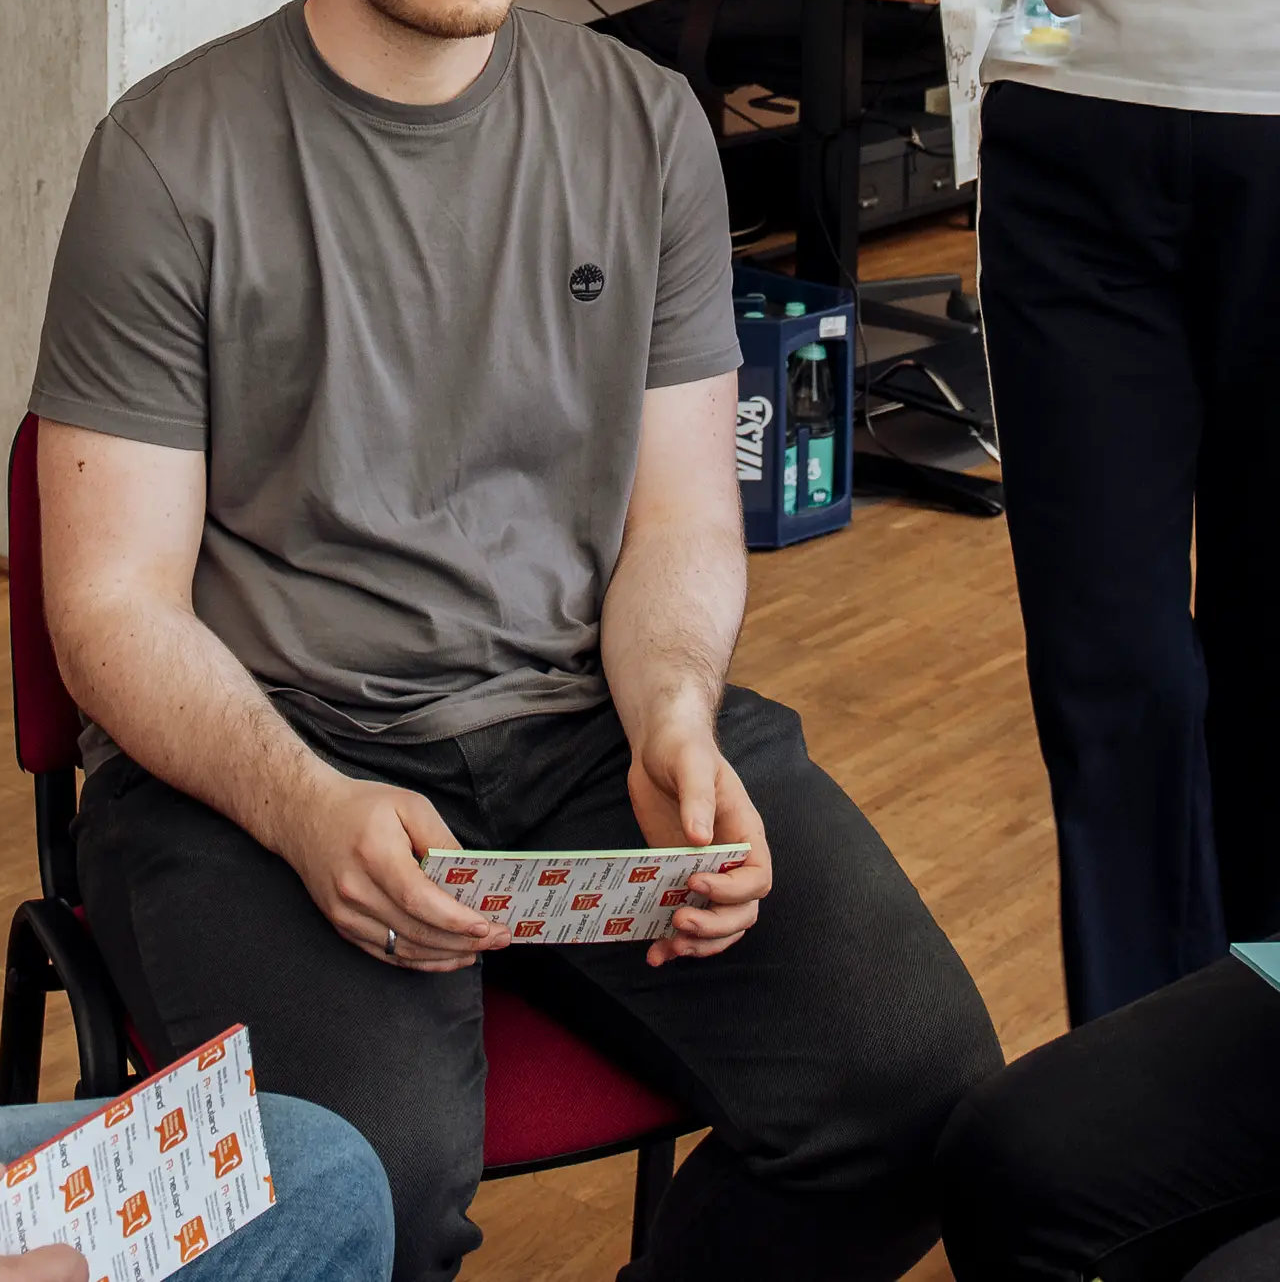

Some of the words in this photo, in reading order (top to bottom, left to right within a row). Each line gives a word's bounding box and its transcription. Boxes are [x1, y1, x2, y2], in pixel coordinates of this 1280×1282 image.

[204, 1093, 219, 1136] neuland
[112, 1151, 127, 1194] neuland
[168, 1176, 184, 1219] neuland
